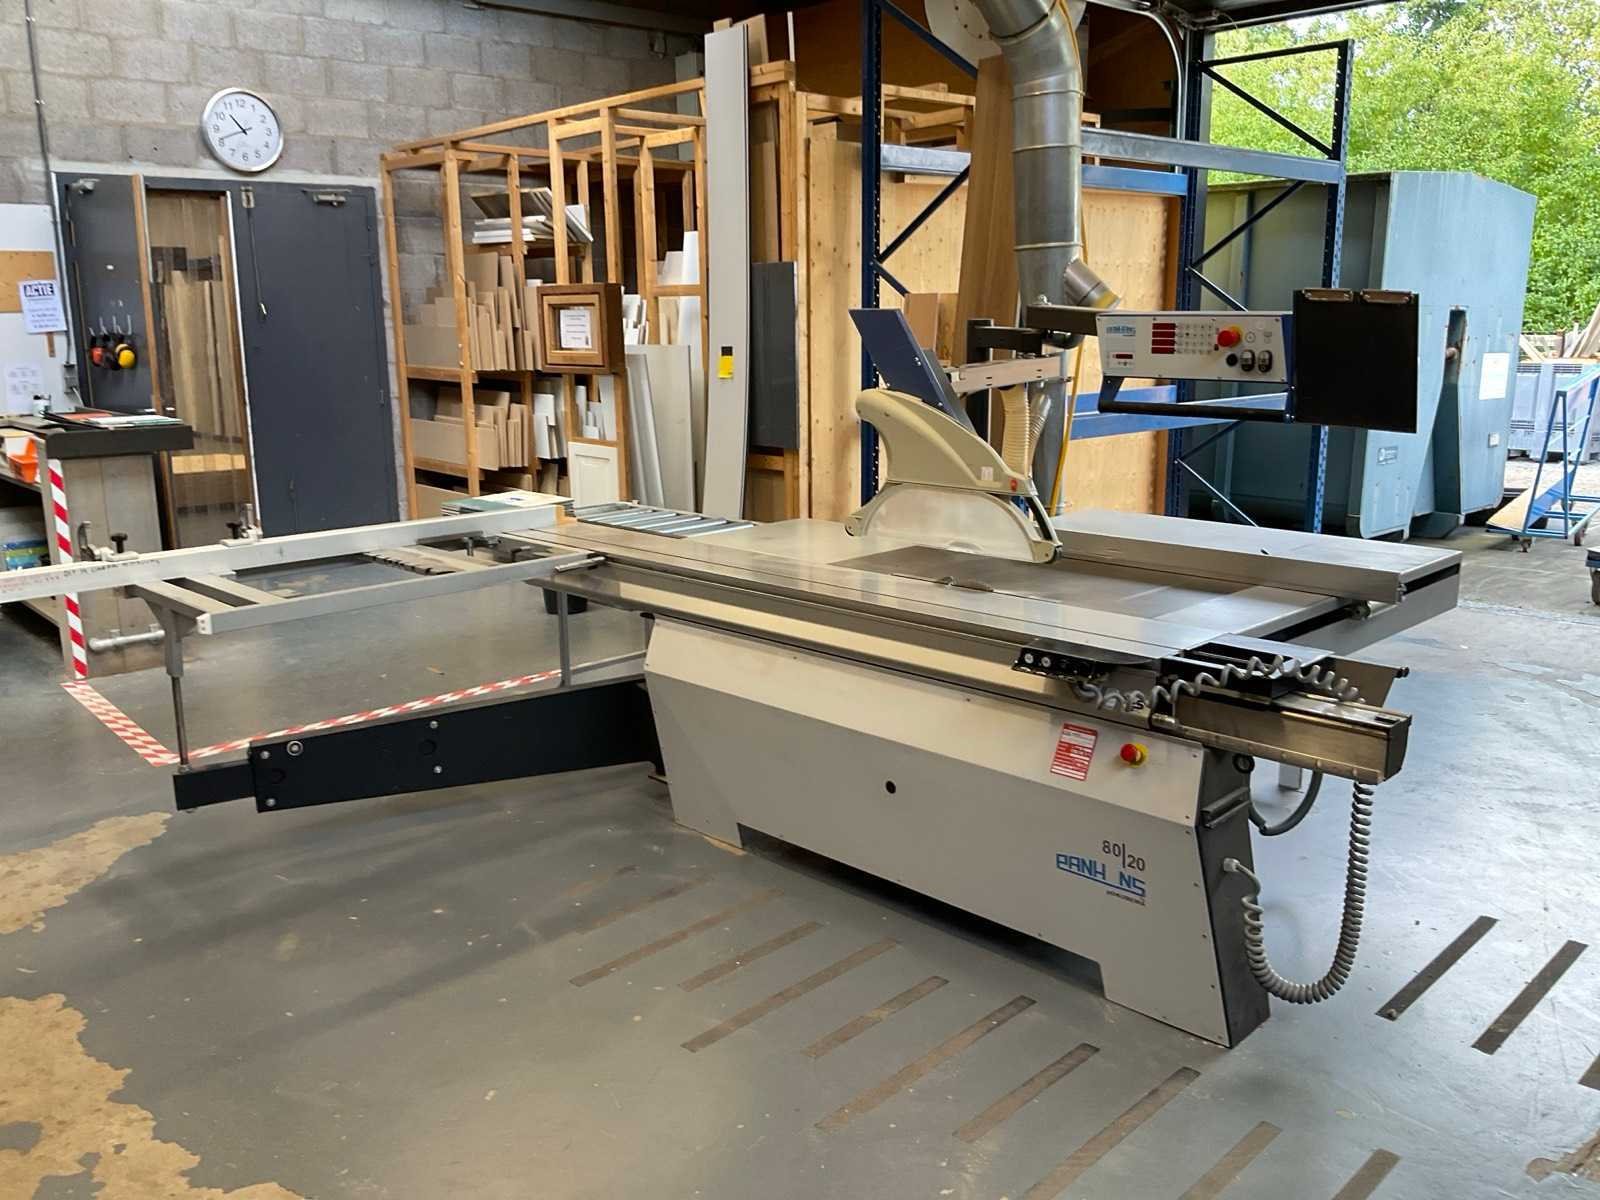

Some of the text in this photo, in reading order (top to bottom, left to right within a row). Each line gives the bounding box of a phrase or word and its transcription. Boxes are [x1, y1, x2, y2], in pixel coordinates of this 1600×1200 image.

[223, 101, 233, 110] 11
[235, 99, 246, 108] 12
[214, 111, 226, 121] 10
[260, 114, 266, 124] 2
[213, 124, 220, 133] 9
[265, 127, 272, 137] 3
[218, 136, 225, 147] 8
[228, 147, 236, 157] 7
[242, 152, 249, 161] 6
[254, 149, 262, 159] 5
[25, 284, 53, 296] ACTIE
